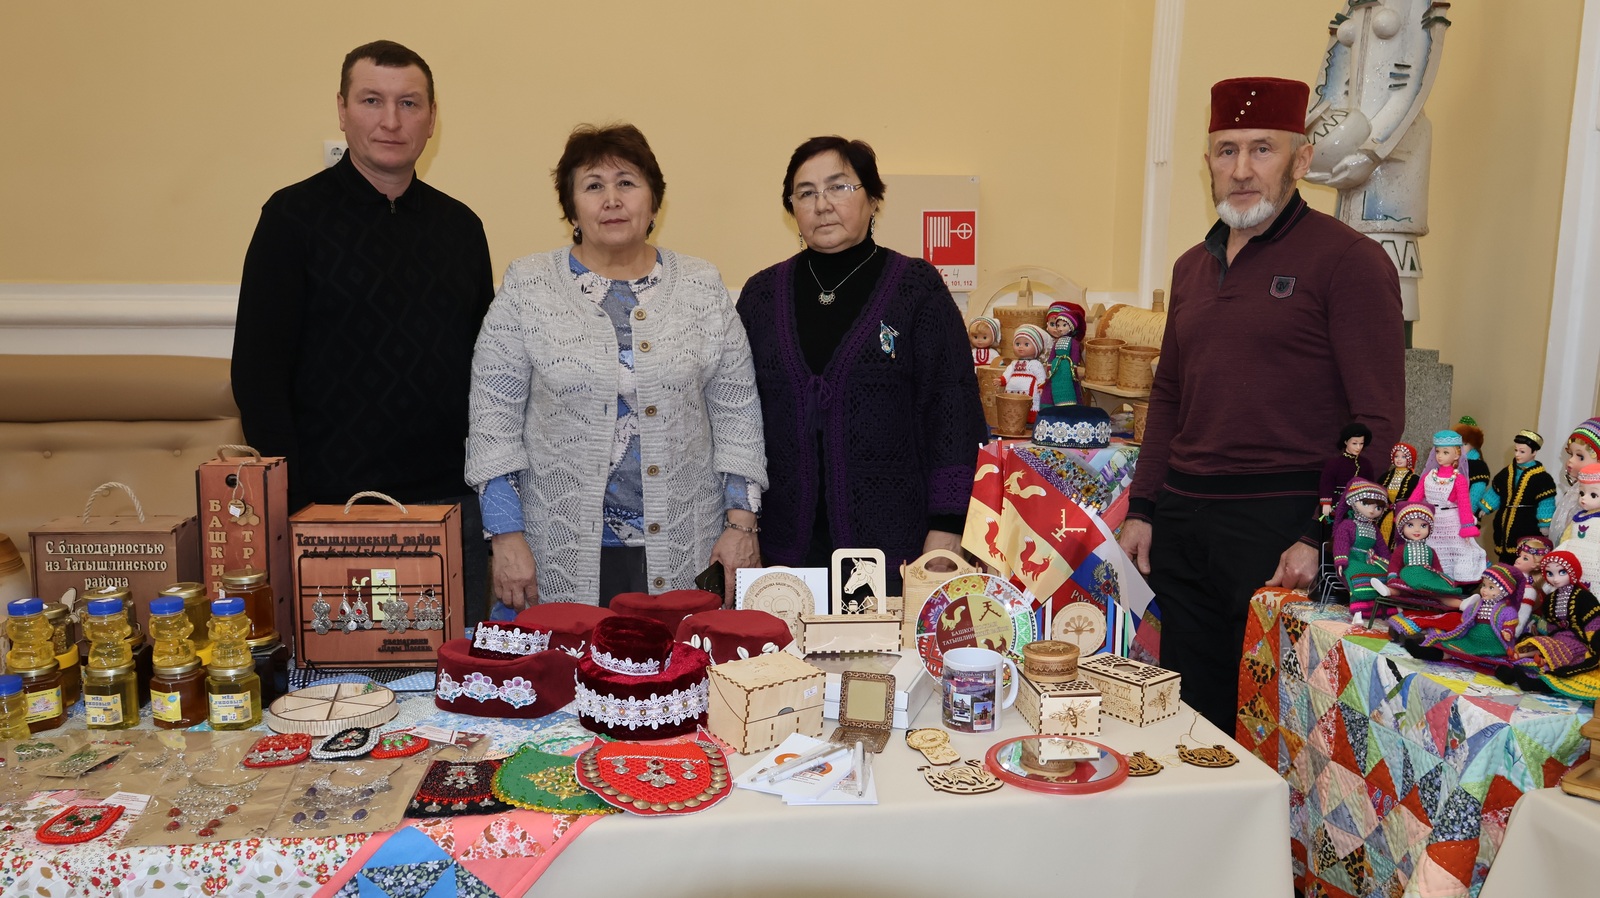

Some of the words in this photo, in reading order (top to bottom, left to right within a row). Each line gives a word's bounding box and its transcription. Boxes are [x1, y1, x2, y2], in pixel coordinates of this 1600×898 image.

[295, 533, 399, 546] Татышлинский
[403, 534, 441, 546] район
[45, 541, 54, 554] С
[58, 540, 165, 556] благодарностью
[45, 561, 60, 571] из
[64, 557, 168, 571] Татышлинского
[84, 575, 129, 590] района
